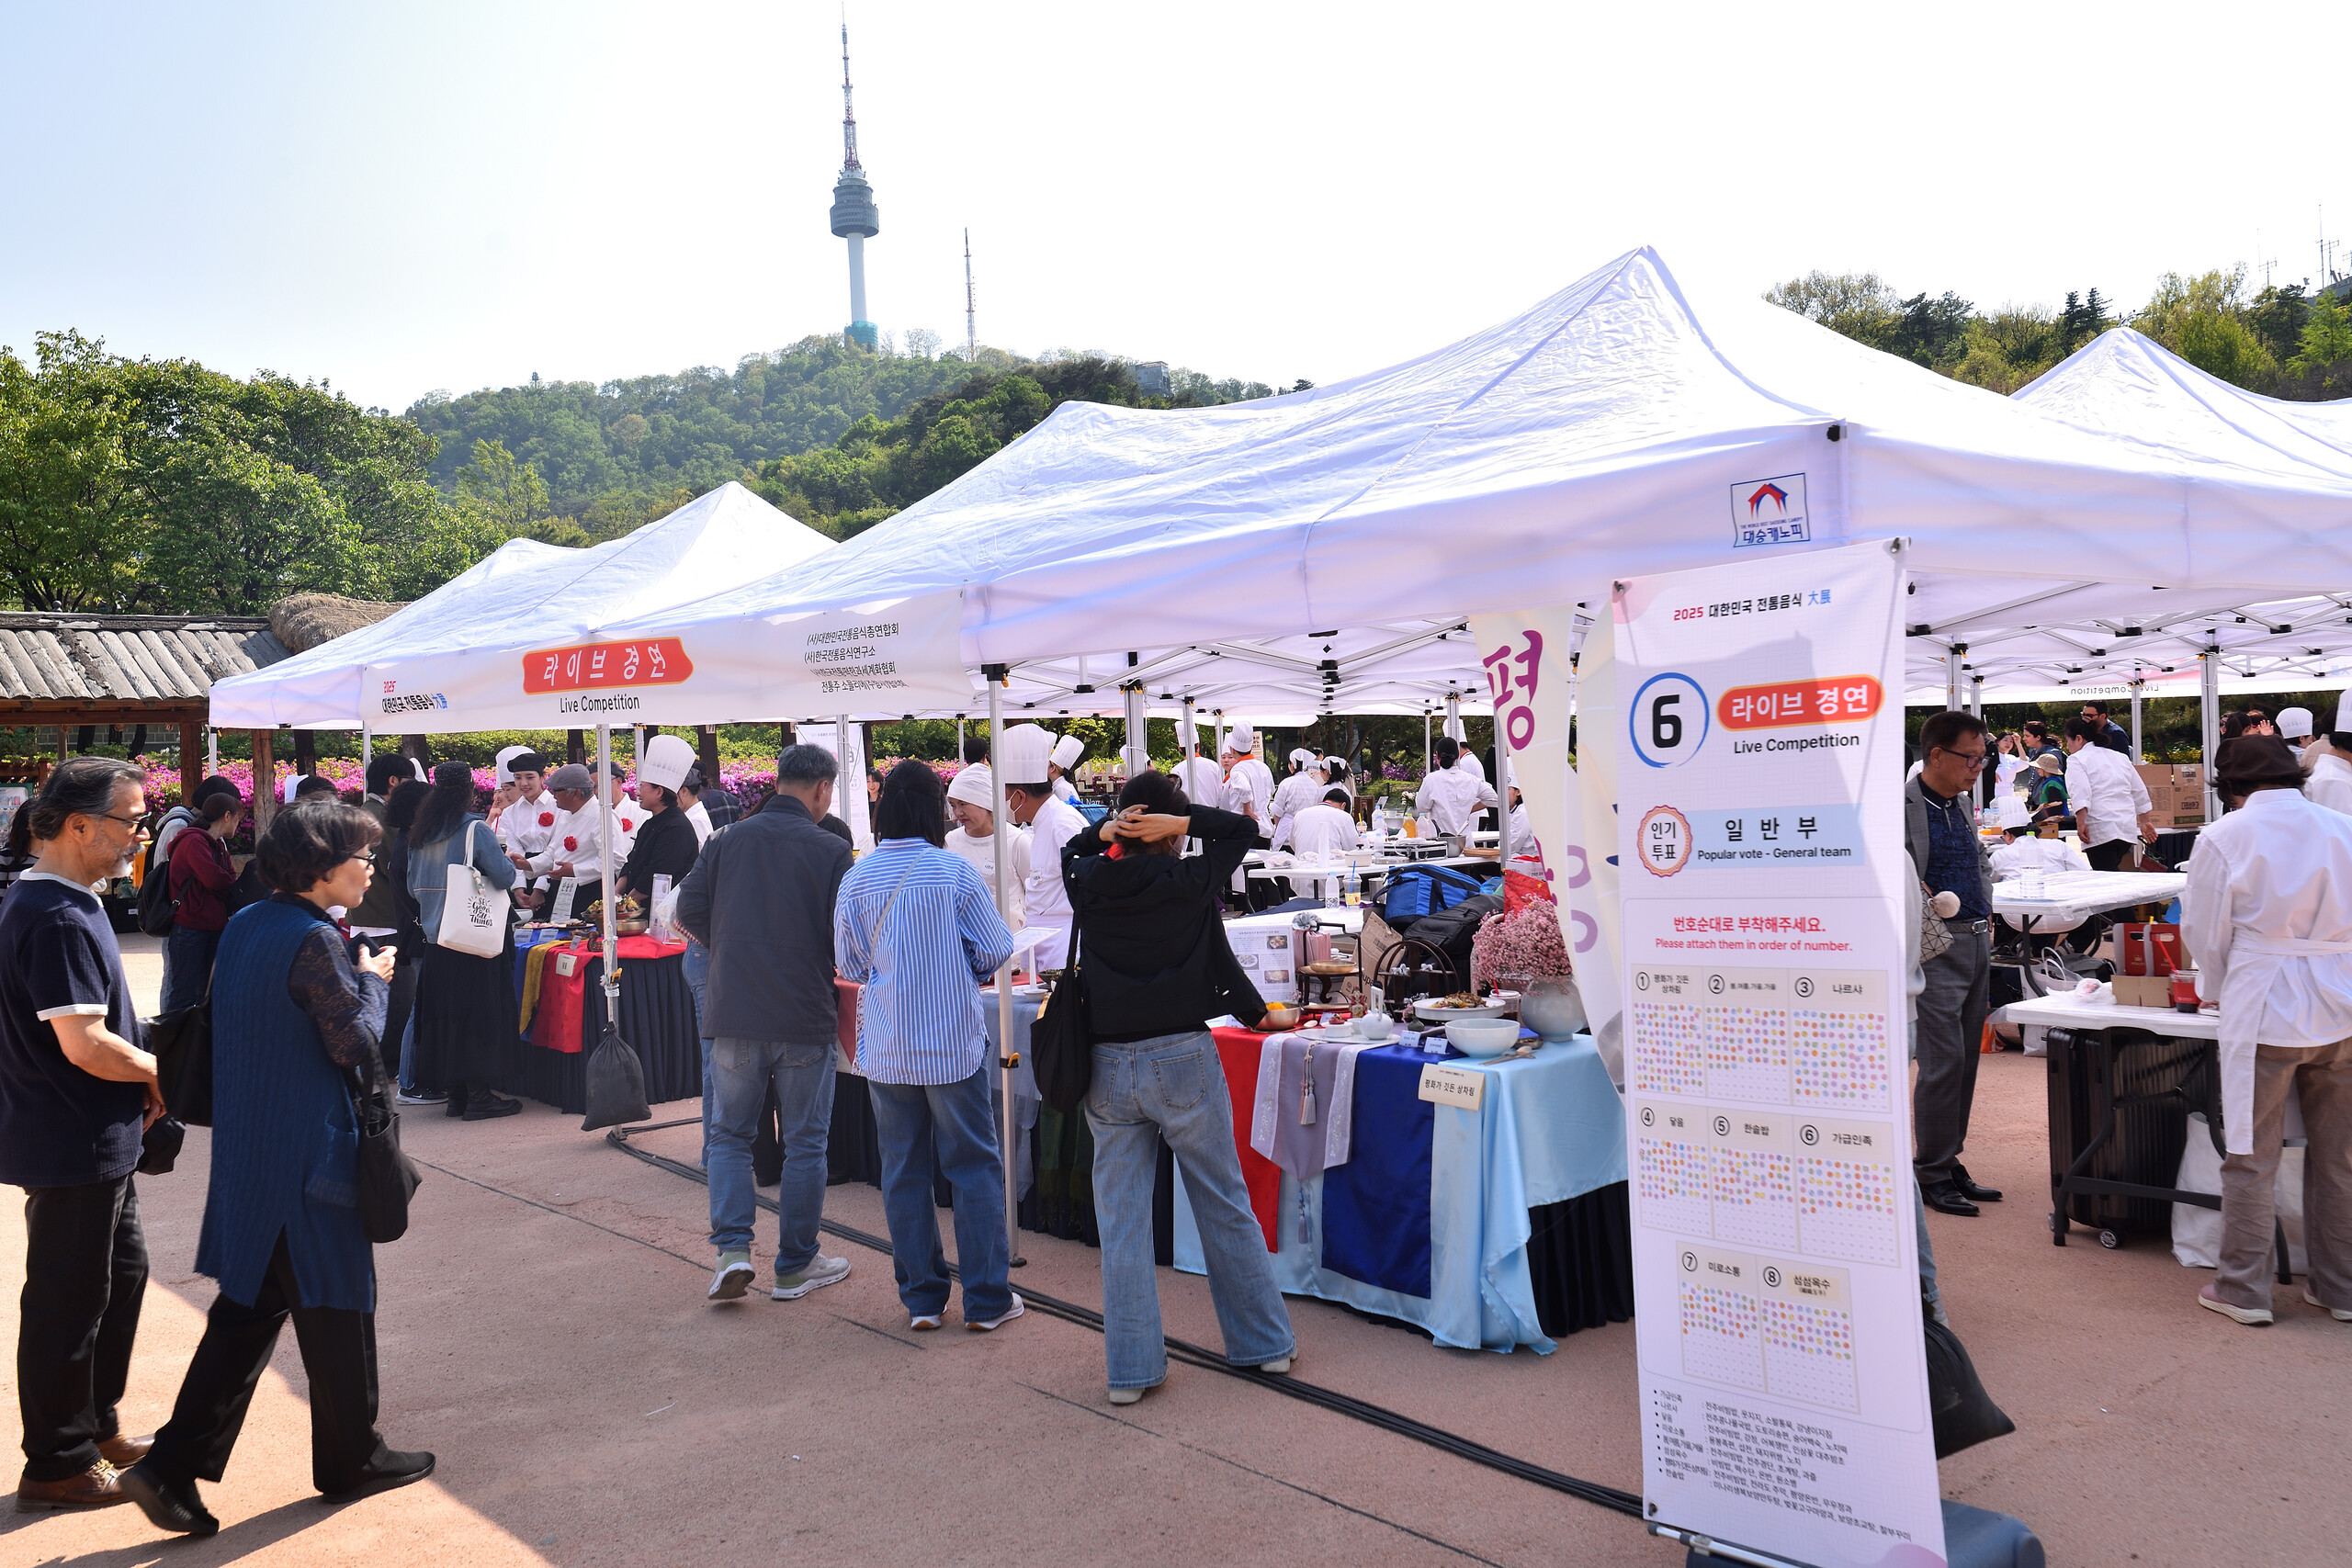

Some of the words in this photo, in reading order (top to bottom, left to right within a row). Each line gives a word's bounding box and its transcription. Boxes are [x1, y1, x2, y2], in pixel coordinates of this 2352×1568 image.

[1743, 524, 1803, 544] 대승캐노피
[1674, 607, 1704, 621] 2025
[1709, 601, 1752, 618] 대한민국
[1757, 593, 1803, 614] 전통음식
[1808, 589, 1831, 606] 大展
[544, 650, 606, 686] 라이브
[624, 644, 666, 680] 경연
[560, 697, 578, 714] Live
[582, 694, 639, 714] Competition
[1732, 693, 1804, 722] 라이브
[1815, 684, 1869, 716] 경연
[1652, 694, 1681, 749] 6
[1735, 740, 1762, 754] Live
[1766, 734, 1860, 753] Competition
[1651, 821, 1677, 840] 인기
[1652, 844, 1677, 862] 투표
[1698, 849, 1736, 863] Popular
[1737, 850, 1763, 860] vote
[1773, 847, 1817, 859] General
[1820, 847, 1851, 858] team
[1673, 917, 1735, 932] 번호순대로
[1737, 917, 1826, 933] 부착해주세요.
[1656, 938, 1683, 949] Please
[1686, 939, 1716, 950] attach
[1718, 940, 1744, 950] them
[1747, 940, 1756, 950] in
[1758, 940, 1787, 951] order
[1790, 940, 1802, 951] of
[1804, 941, 1853, 952] number.
[1832, 984, 1862, 995] 나르샤
[1425, 1079, 1442, 1090] 평화가
[1444, 1082, 1455, 1093] 깃든
[1457, 1086, 1475, 1097] 상차림
[1832, 1133, 1873, 1147] 가급인족
[1793, 1274, 1831, 1290] 섬섬옥수
